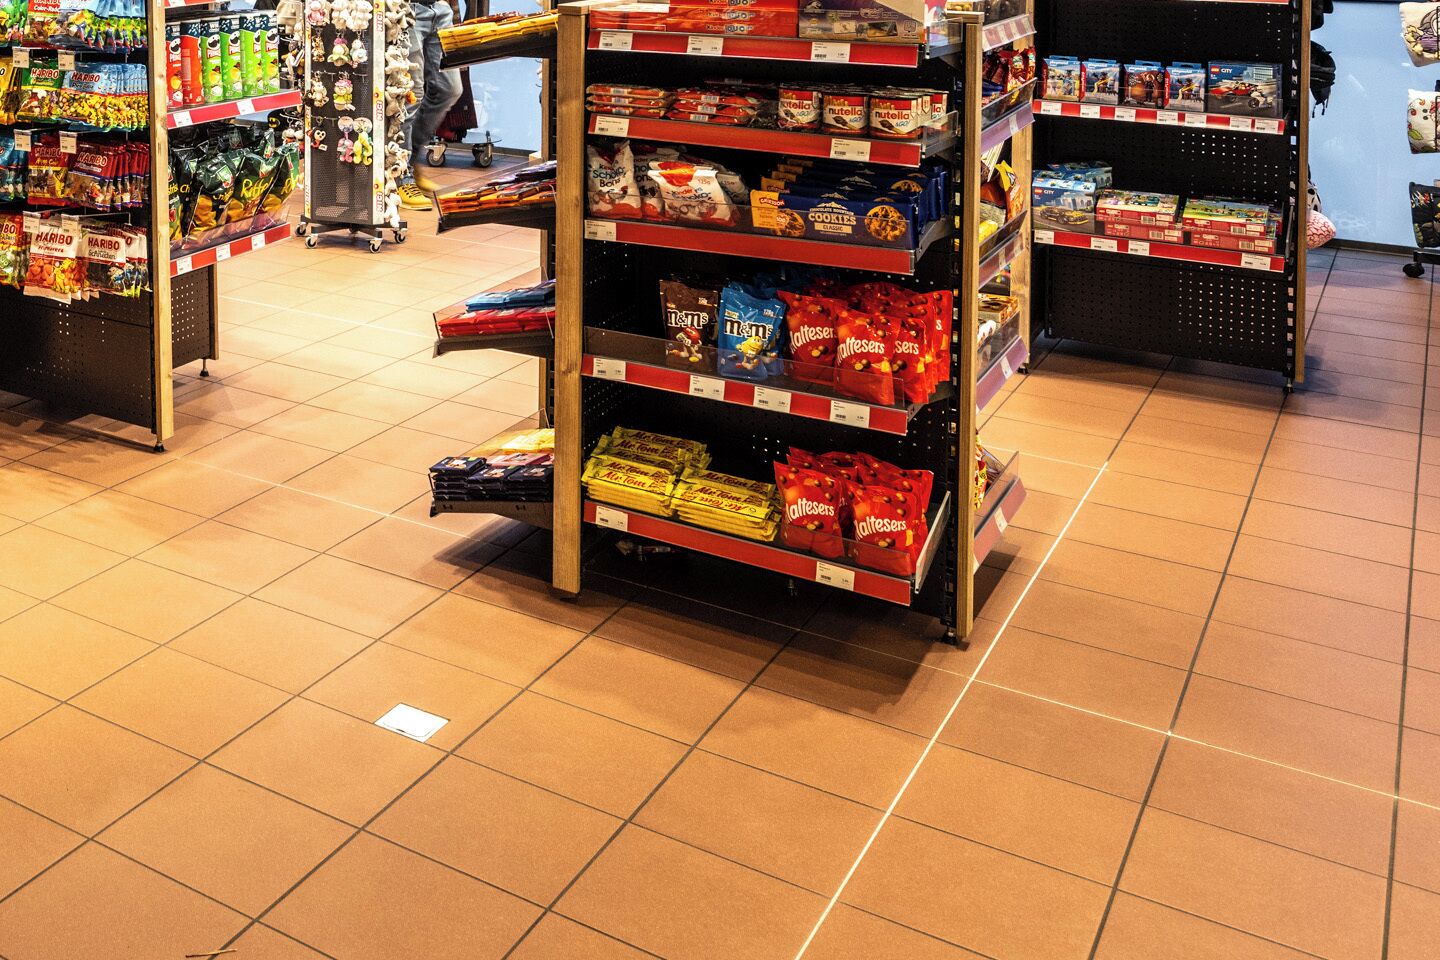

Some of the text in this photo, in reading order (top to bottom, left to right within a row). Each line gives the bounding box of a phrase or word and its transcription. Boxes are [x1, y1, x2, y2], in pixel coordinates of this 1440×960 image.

[30, 68, 59, 79] HARIBO
[71, 70, 101, 83] HARIBO
[828, 107, 863, 116] nutella
[875, 112, 910, 120] nutella
[78, 151, 108, 166] HARIBO
[599, 178, 621, 188] Bons
[759, 197, 785, 207] GRIESSON
[808, 212, 857, 226] COOKIES
[35, 232, 73, 245] HARIBO
[88, 237, 120, 250] HARIBO
[636, 441, 659, 453] Tom
[624, 463, 650, 477] Tom
[603, 471, 647, 488] Mr. Tom
[721, 474, 749, 488] Tom
[715, 488, 743, 503] Tom
